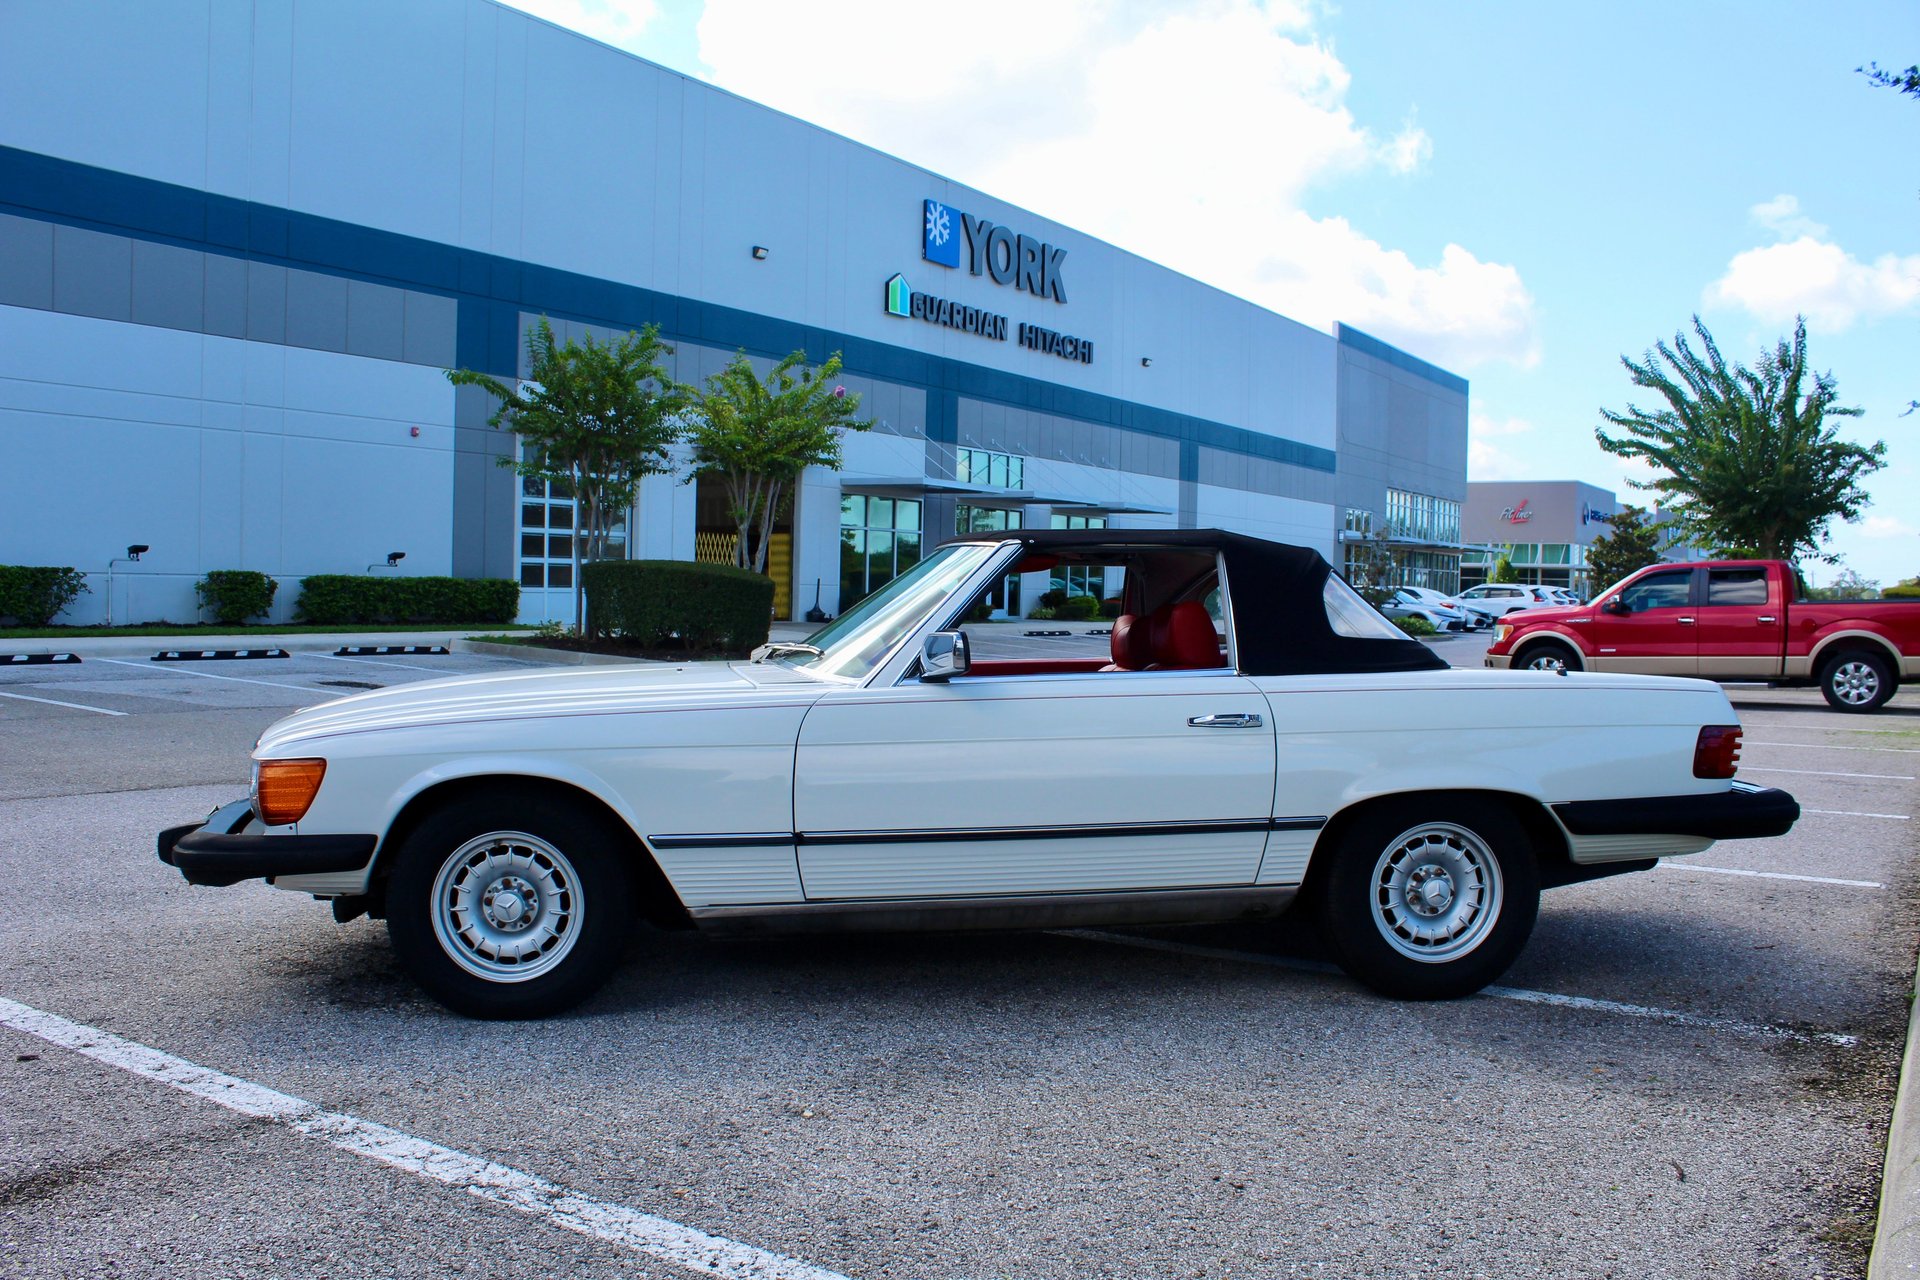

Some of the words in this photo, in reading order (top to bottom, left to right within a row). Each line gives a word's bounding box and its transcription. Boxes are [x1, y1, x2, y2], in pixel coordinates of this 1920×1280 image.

[961, 212, 1067, 304] YORK
[911, 292, 1008, 341] GUARDIAN
[1019, 322, 1093, 364] HITACHI
